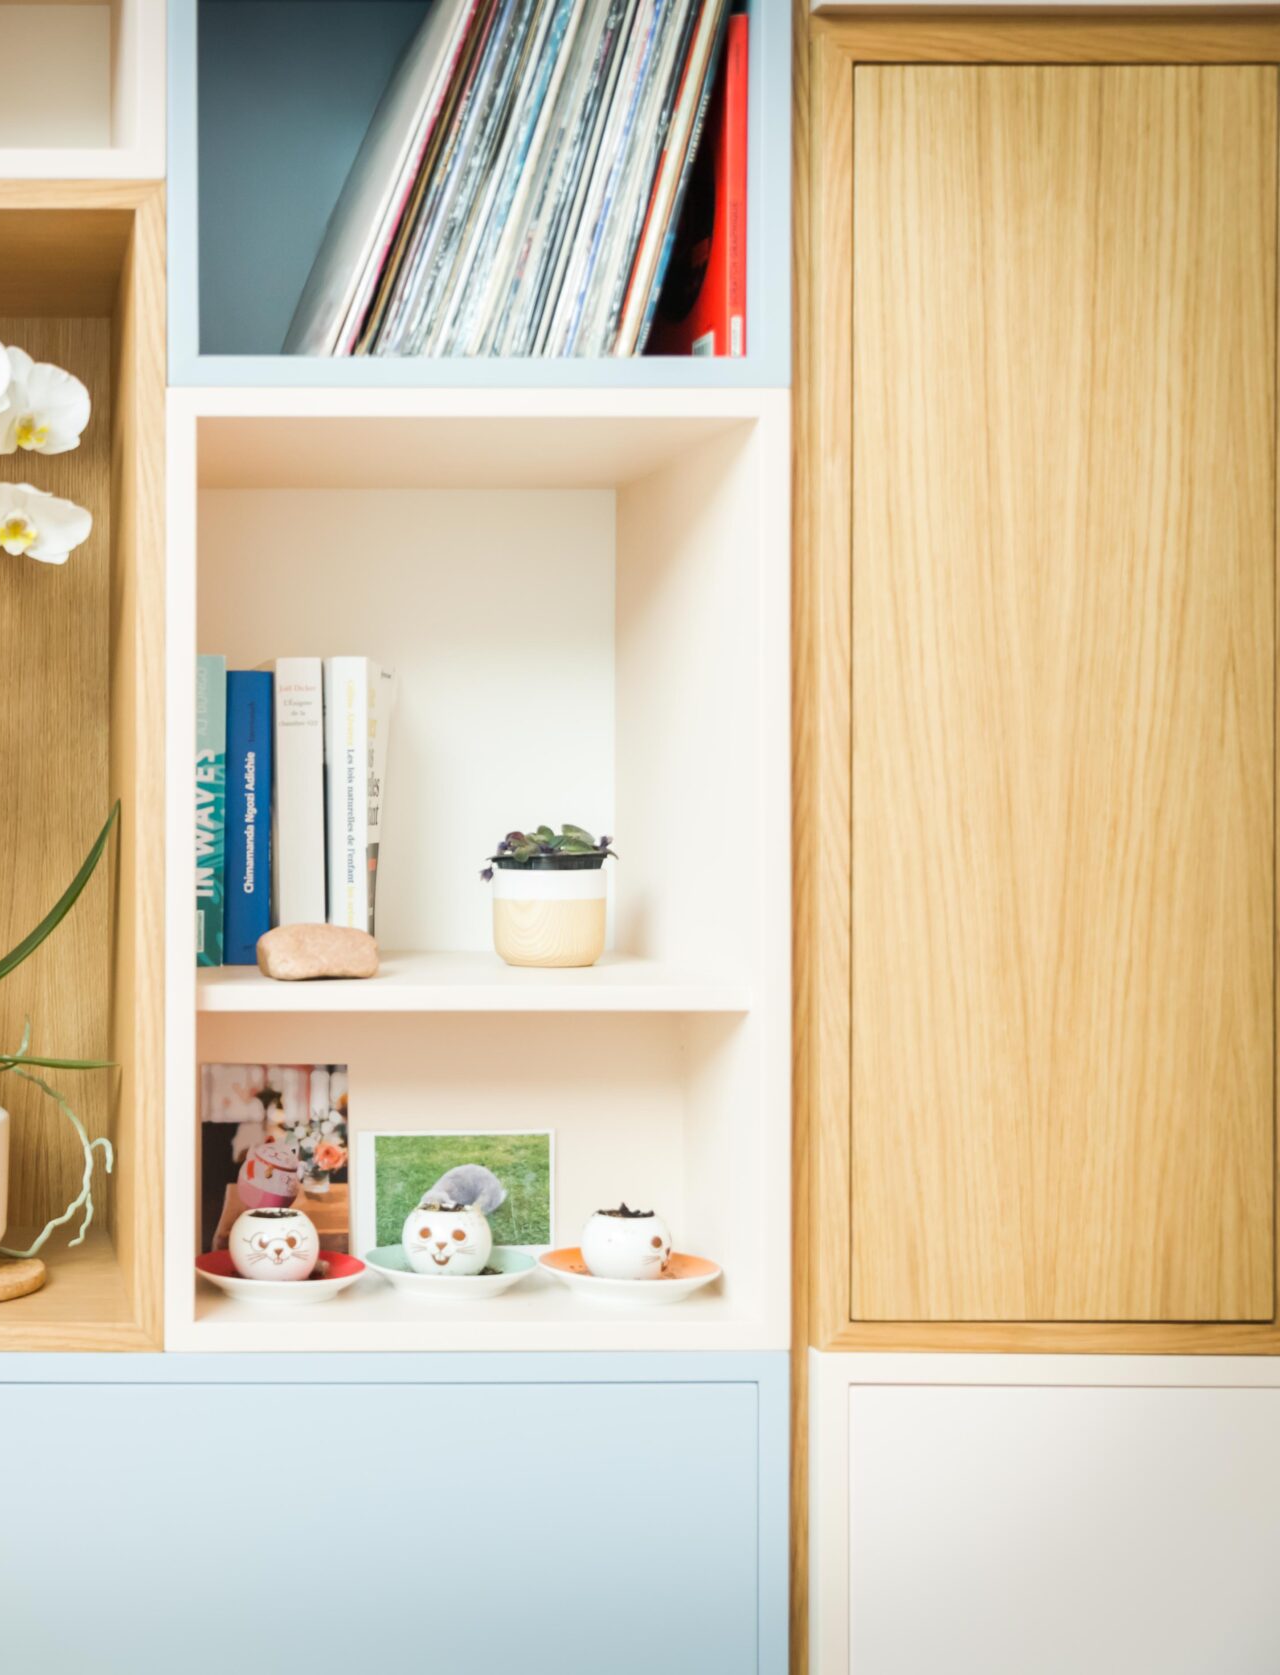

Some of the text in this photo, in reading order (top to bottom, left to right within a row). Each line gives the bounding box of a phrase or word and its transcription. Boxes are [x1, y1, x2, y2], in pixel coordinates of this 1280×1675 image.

[244, 751, 256, 791] Adichie
[346, 748, 355, 764] Les
[346, 766, 355, 783] lois
[196, 748, 216, 857] WAVES
[244, 793, 257, 823] Ngozi
[346, 786, 355, 832] naturelles
[346, 834, 355, 846] de
[243, 825, 255, 894] Chimamanda
[346, 848, 355, 884] l'enfant
[196, 867, 214, 897] IN
